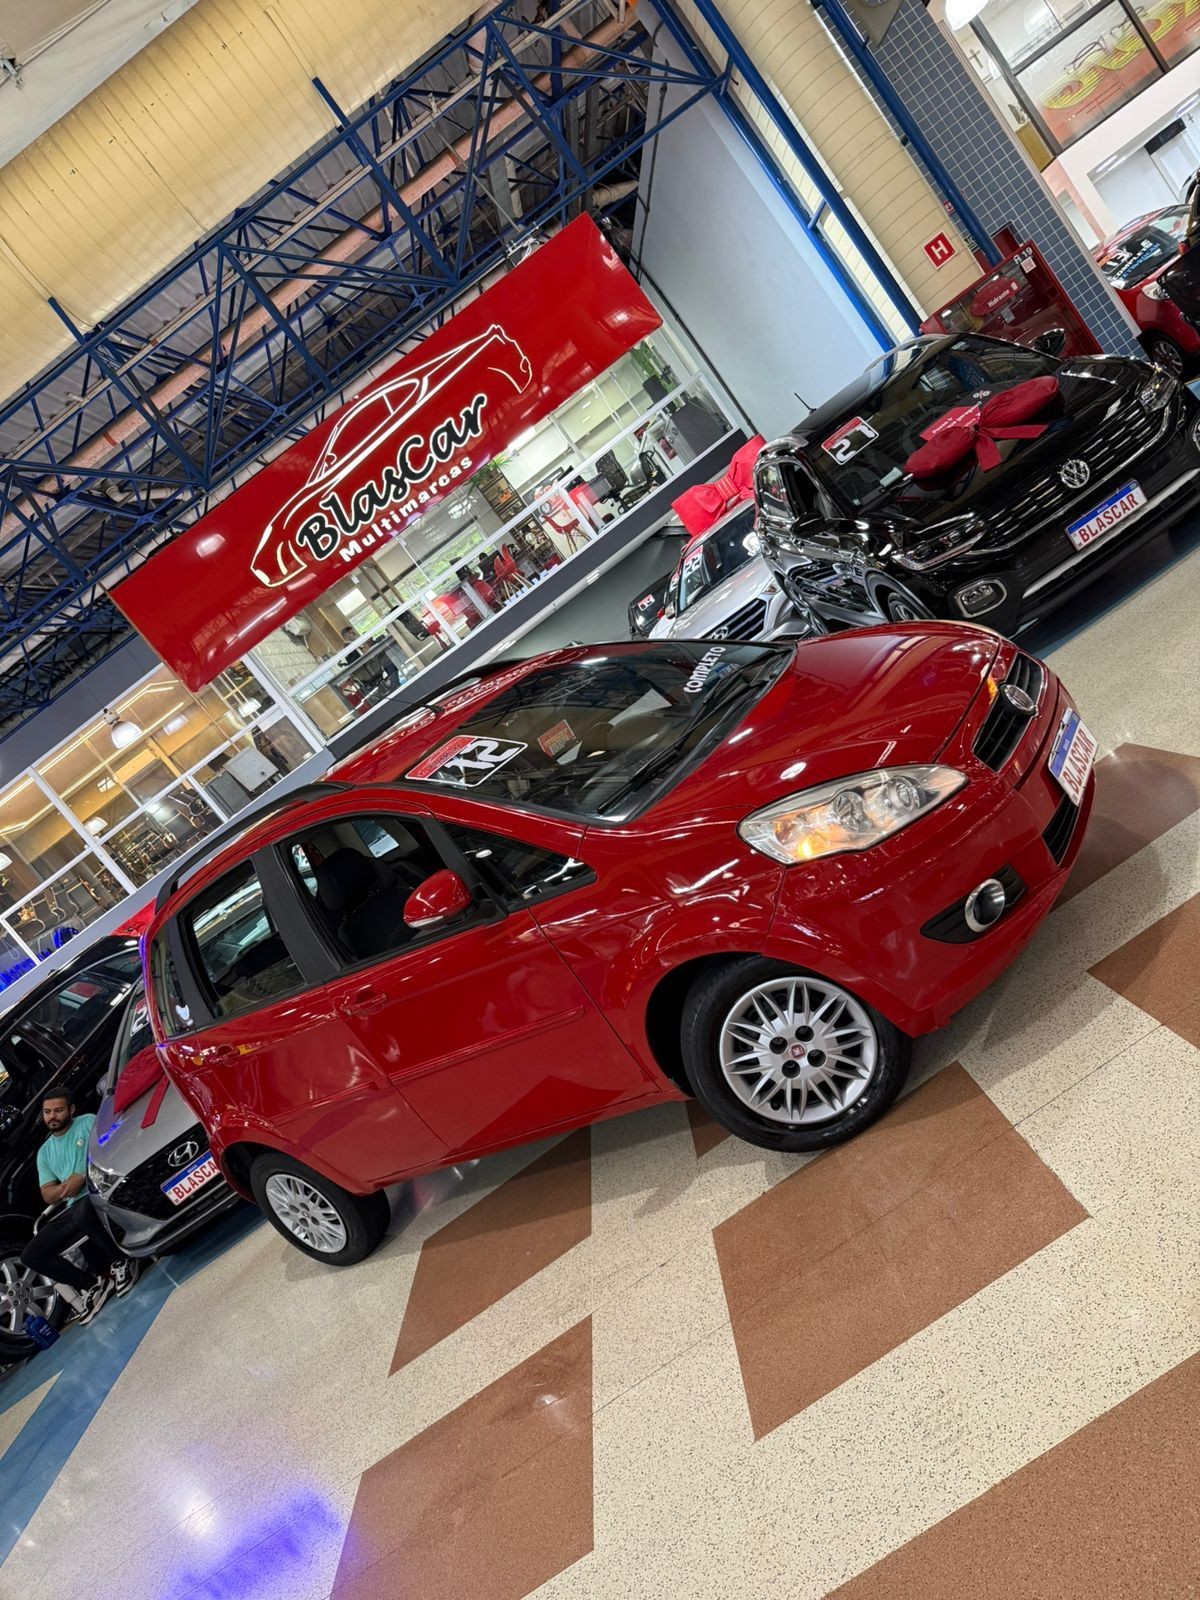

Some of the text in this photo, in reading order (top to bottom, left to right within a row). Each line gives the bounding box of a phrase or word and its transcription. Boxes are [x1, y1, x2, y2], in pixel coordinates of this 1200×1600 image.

[930, 239, 949, 260] H
[987, 289, 1010, 309] Hidrante
[831, 424, 877, 462] 21
[296, 393, 488, 561] BlasCar
[339, 455, 474, 563] Multimarcas
[1078, 492, 1139, 543] BLASCAR
[682, 645, 727, 695] COMPLETO
[1062, 727, 1095, 796] BLASCAR
[132, 1007, 150, 1033] 2
